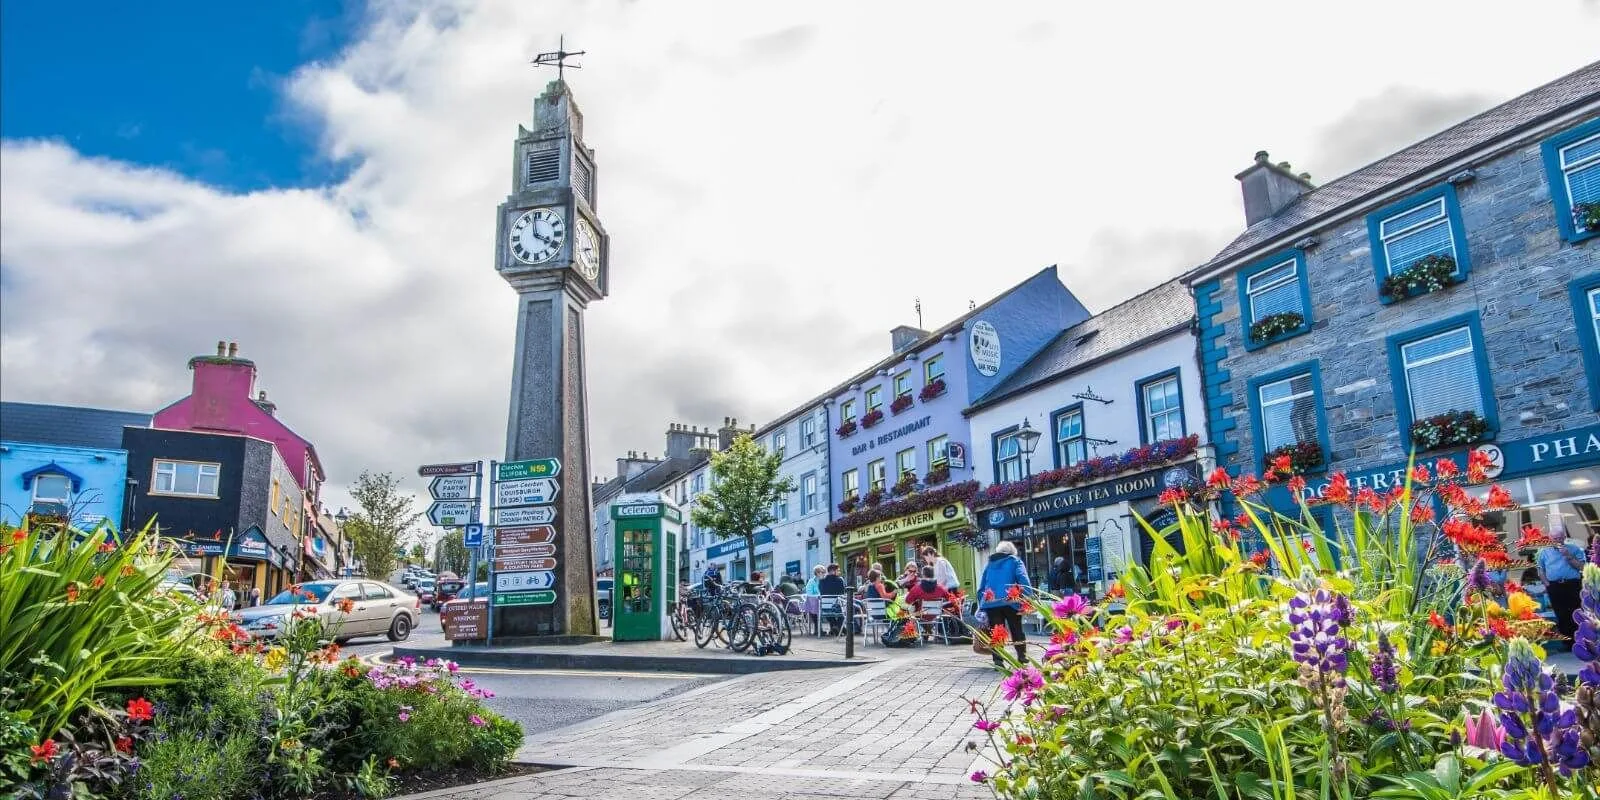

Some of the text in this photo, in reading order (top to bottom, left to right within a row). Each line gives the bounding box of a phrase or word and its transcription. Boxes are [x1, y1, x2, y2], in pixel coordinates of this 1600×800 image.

[852, 442, 867, 456] BAR
[877, 415, 931, 446] RESTAURANT
[1529, 433, 1600, 462] PHA
[500, 470, 528, 478] CLIFDEN
[530, 464, 547, 473] N59
[500, 489, 541, 497] LOUISBURGH
[1088, 487, 1109, 502] TEA
[1115, 476, 1156, 496] ROOM
[856, 527, 871, 539] THE
[873, 521, 899, 535] CLOCK
[901, 511, 934, 528] TAVERN
